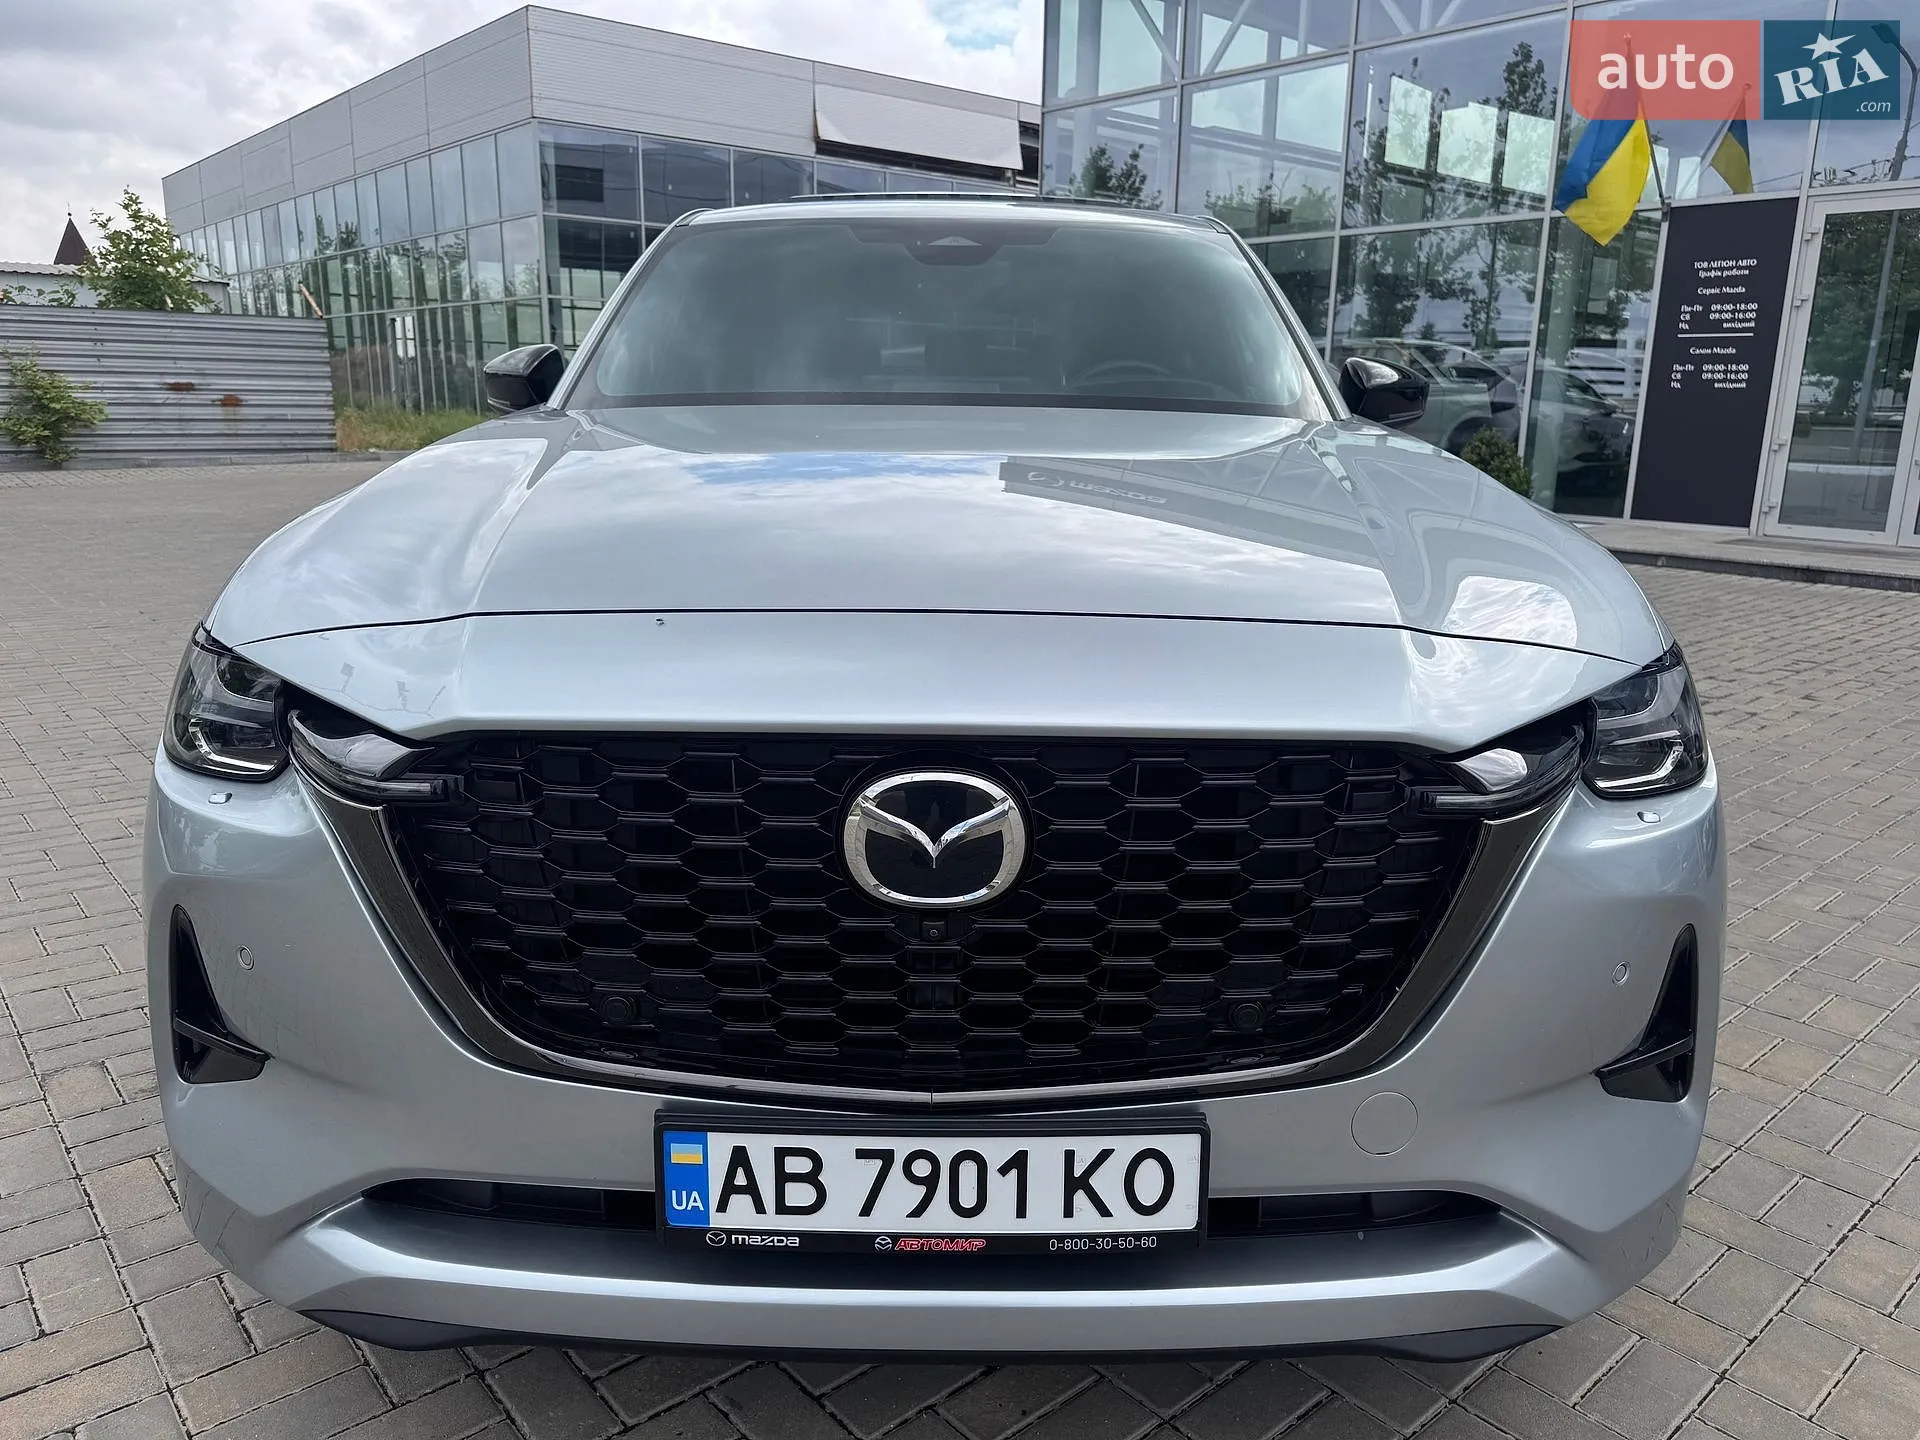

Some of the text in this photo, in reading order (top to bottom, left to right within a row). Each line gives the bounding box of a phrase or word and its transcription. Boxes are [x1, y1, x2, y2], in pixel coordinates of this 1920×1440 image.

[1722, 285, 1746, 293] Mazda
[1711, 303, 1758, 311] 09:00-18:00
[1709, 312, 1756, 320] 09:00-16:00
[1712, 346, 1736, 354] Mazda
[1702, 363, 1749, 371] 09:00-18:00
[1702, 372, 1748, 380] 09:00-16:00
[715, 1144, 1175, 1219] AB 7901 KO
[671, 1190, 704, 1211] UA
[731, 1233, 799, 1247] mazda
[1049, 1236, 1157, 1251] 0-800-30-50-60
[895, 1238, 986, 1251] АВТОМИР
